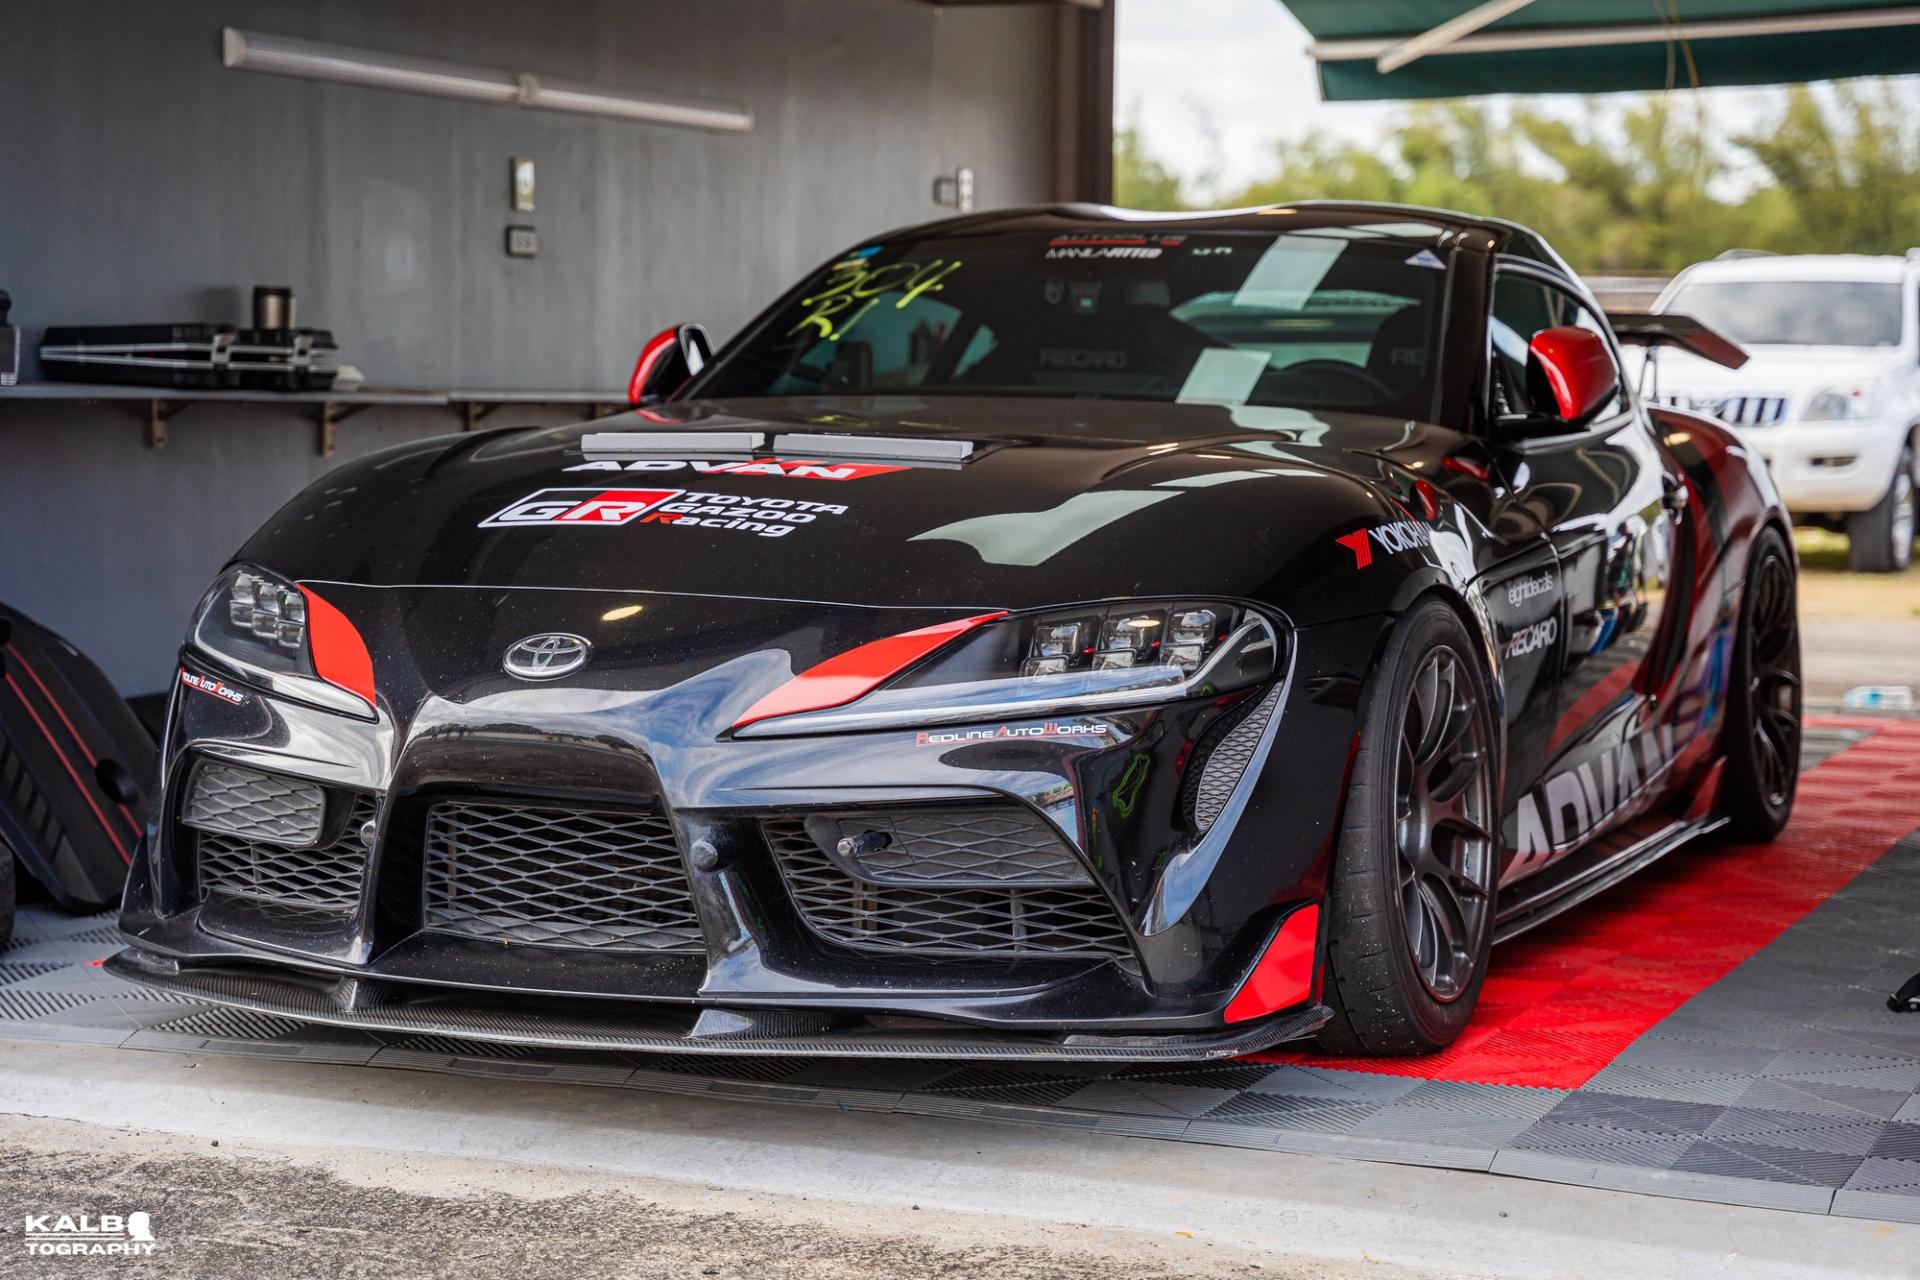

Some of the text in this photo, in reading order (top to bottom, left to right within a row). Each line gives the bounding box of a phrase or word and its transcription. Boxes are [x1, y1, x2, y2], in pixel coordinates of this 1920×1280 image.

[801, 259, 963, 309] 304
[562, 460, 857, 479] ADVAN
[499, 500, 647, 521] GR
[657, 503, 817, 524] GAZOO
[684, 492, 849, 515] TOYOTA
[640, 511, 796, 538] Racing
[1505, 616, 1557, 659] RECARO
